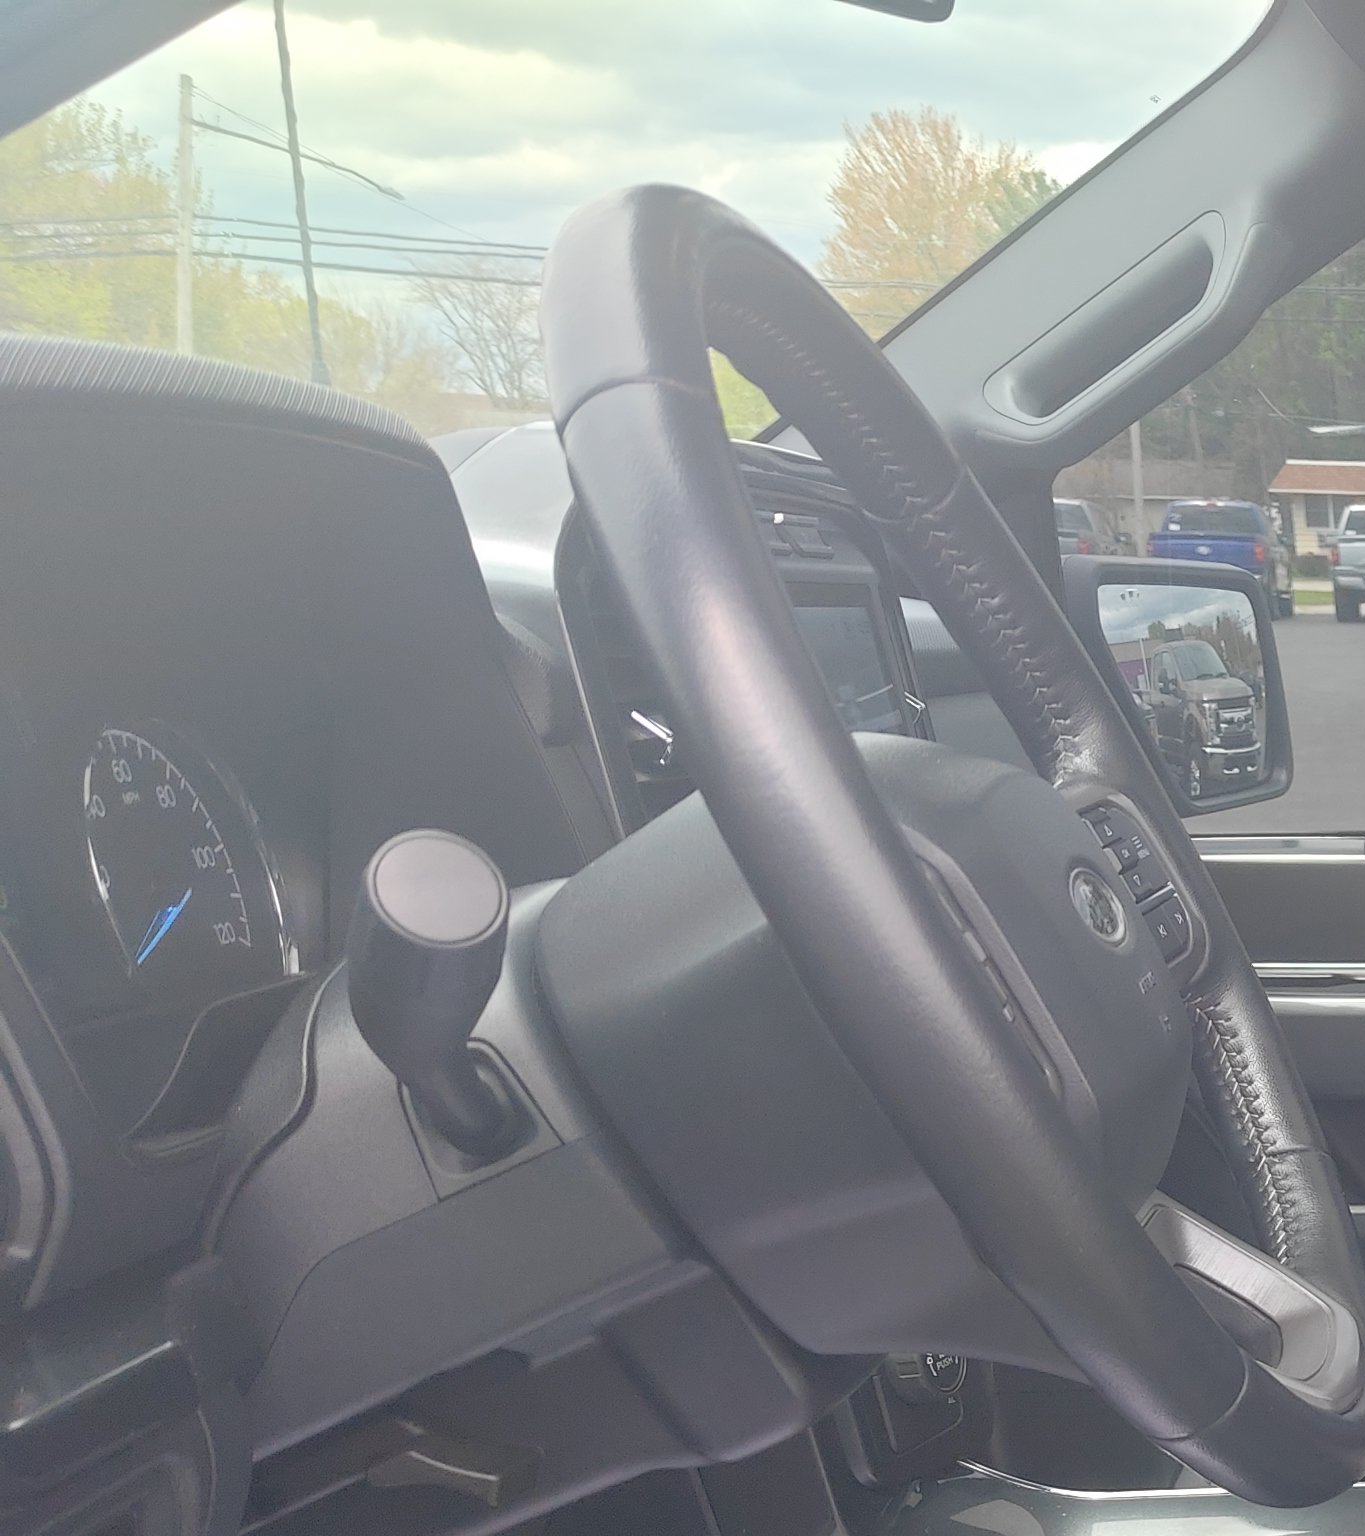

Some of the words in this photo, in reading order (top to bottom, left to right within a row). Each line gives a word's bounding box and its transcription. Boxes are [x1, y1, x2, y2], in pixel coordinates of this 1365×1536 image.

[112, 759, 132, 783] 60
[156, 785, 176, 808] 80
[192, 846, 216, 869] 100
[213, 922, 235, 944] 120
[936, 1356, 954, 1371] PUSH
